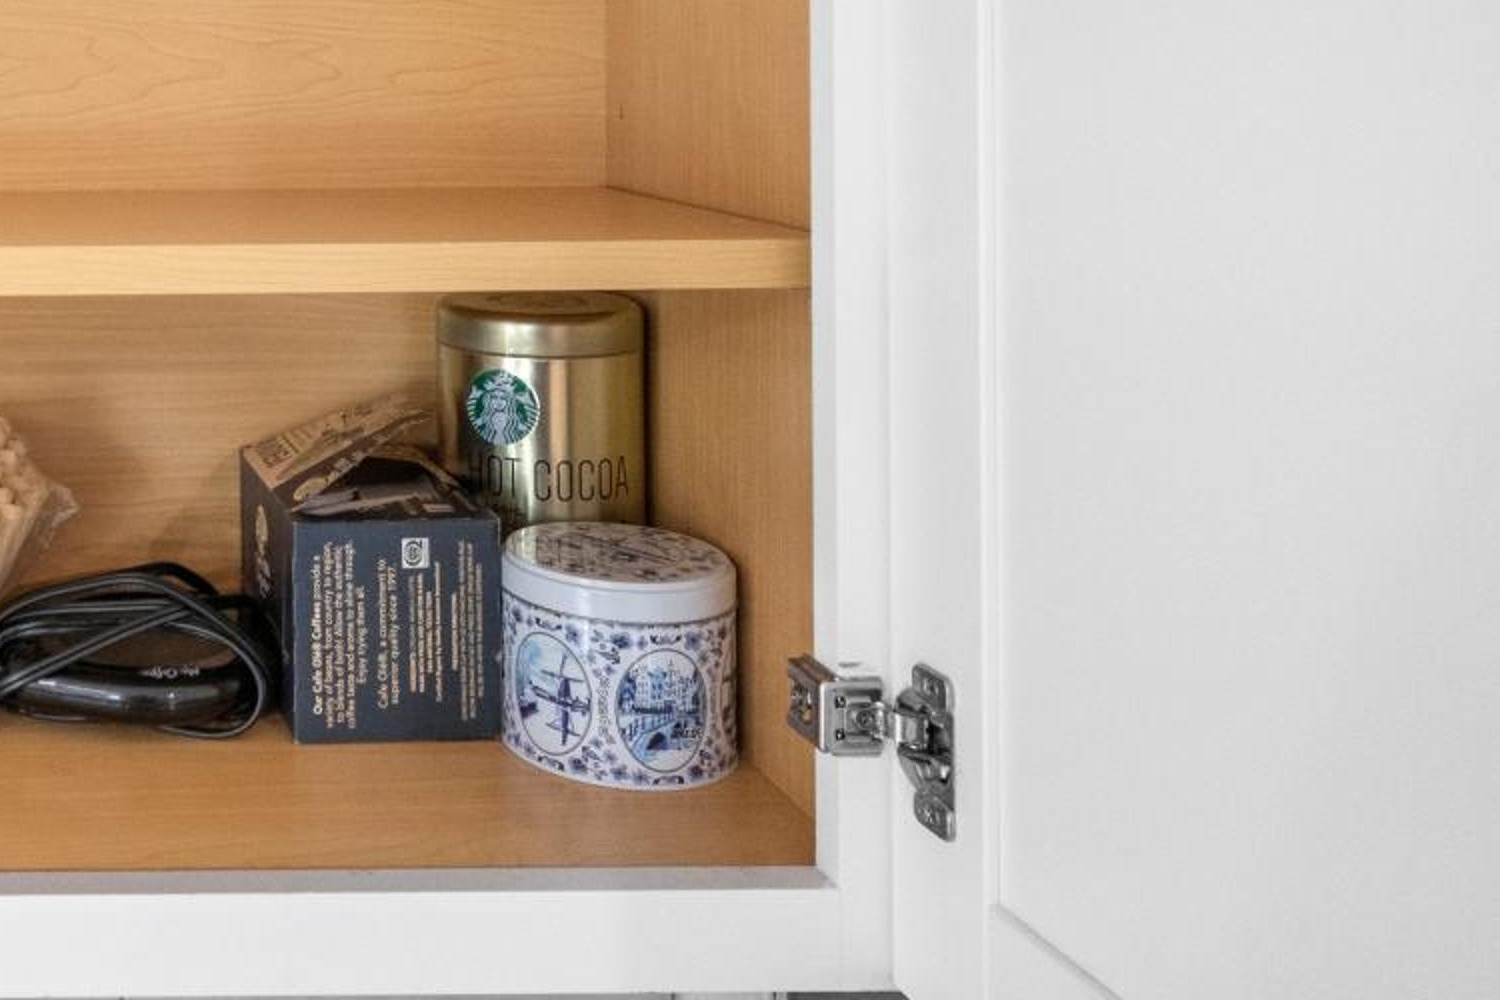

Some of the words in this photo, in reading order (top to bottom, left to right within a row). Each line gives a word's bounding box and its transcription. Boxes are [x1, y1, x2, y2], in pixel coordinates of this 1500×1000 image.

[468, 456, 522, 497] HOT
[534, 456, 628, 501] COCOA
[311, 602, 322, 640] Coffees
